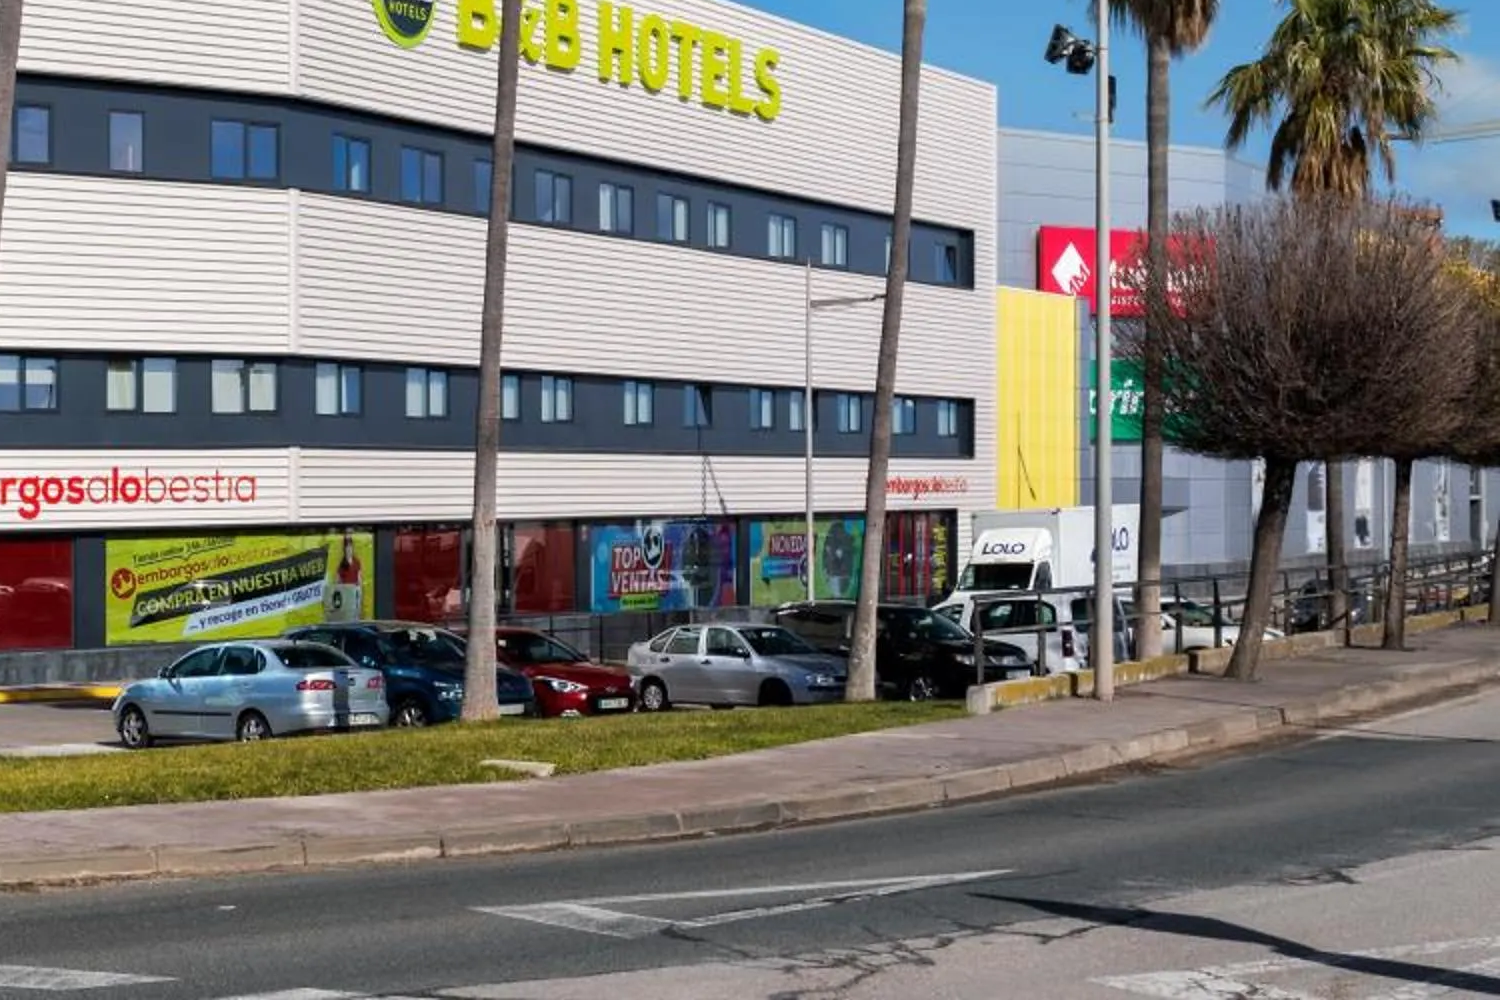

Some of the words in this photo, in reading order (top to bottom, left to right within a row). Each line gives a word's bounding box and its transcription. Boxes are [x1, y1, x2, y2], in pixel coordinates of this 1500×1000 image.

[389, 1, 427, 21] HOTELS
[613, 547, 641, 569] TOP
[981, 542, 1025, 556] LOLO
[137, 588, 204, 616] COMPRA
[210, 585, 229, 600] EN
[233, 565, 298, 594] NUESTRA
[611, 570, 670, 593] VENTAS
